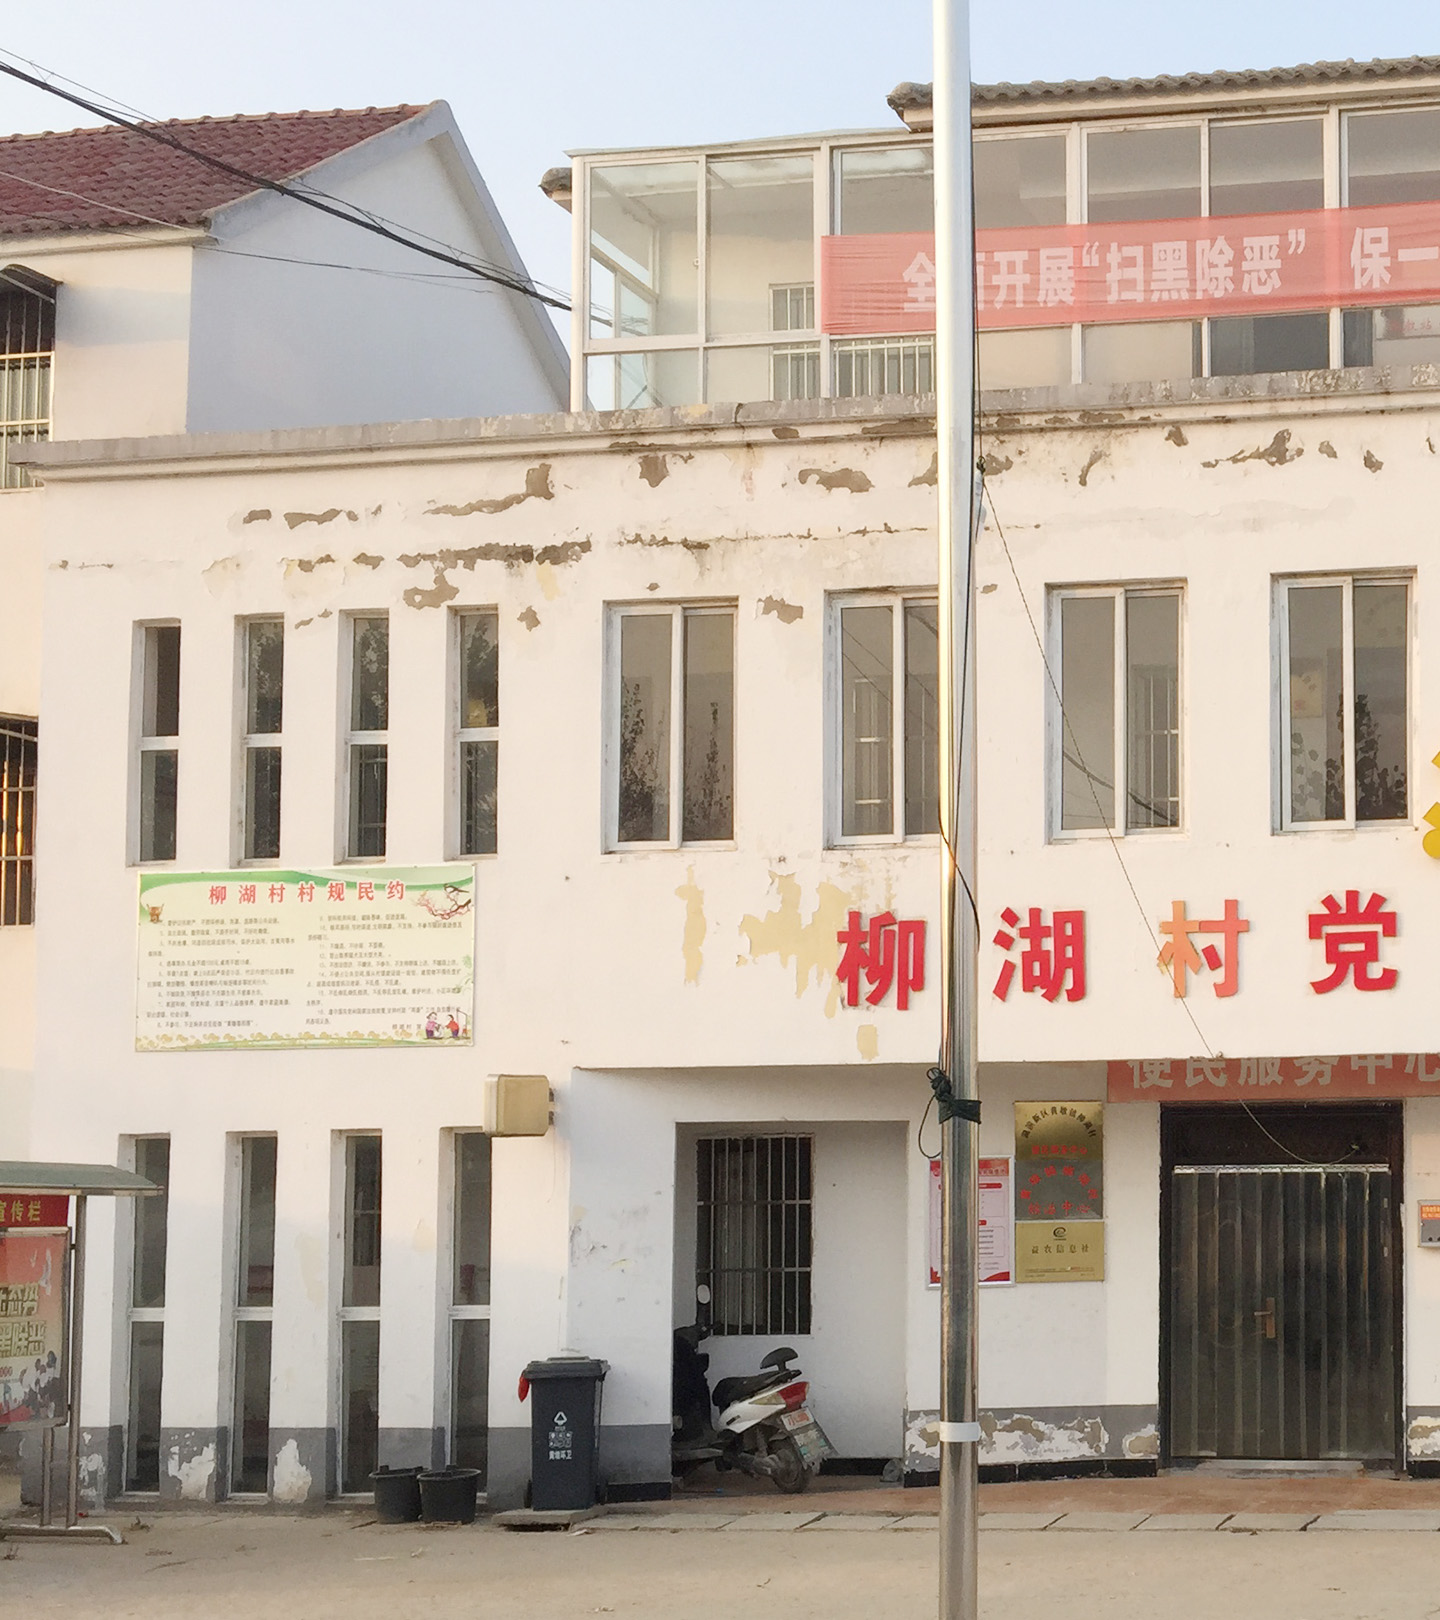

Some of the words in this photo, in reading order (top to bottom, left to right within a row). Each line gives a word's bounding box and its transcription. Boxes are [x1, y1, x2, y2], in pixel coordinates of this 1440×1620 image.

[902, 228, 1306, 312] 全开展“扫黑除恶”
[208, 880, 406, 906] 柳湖村村规民约
